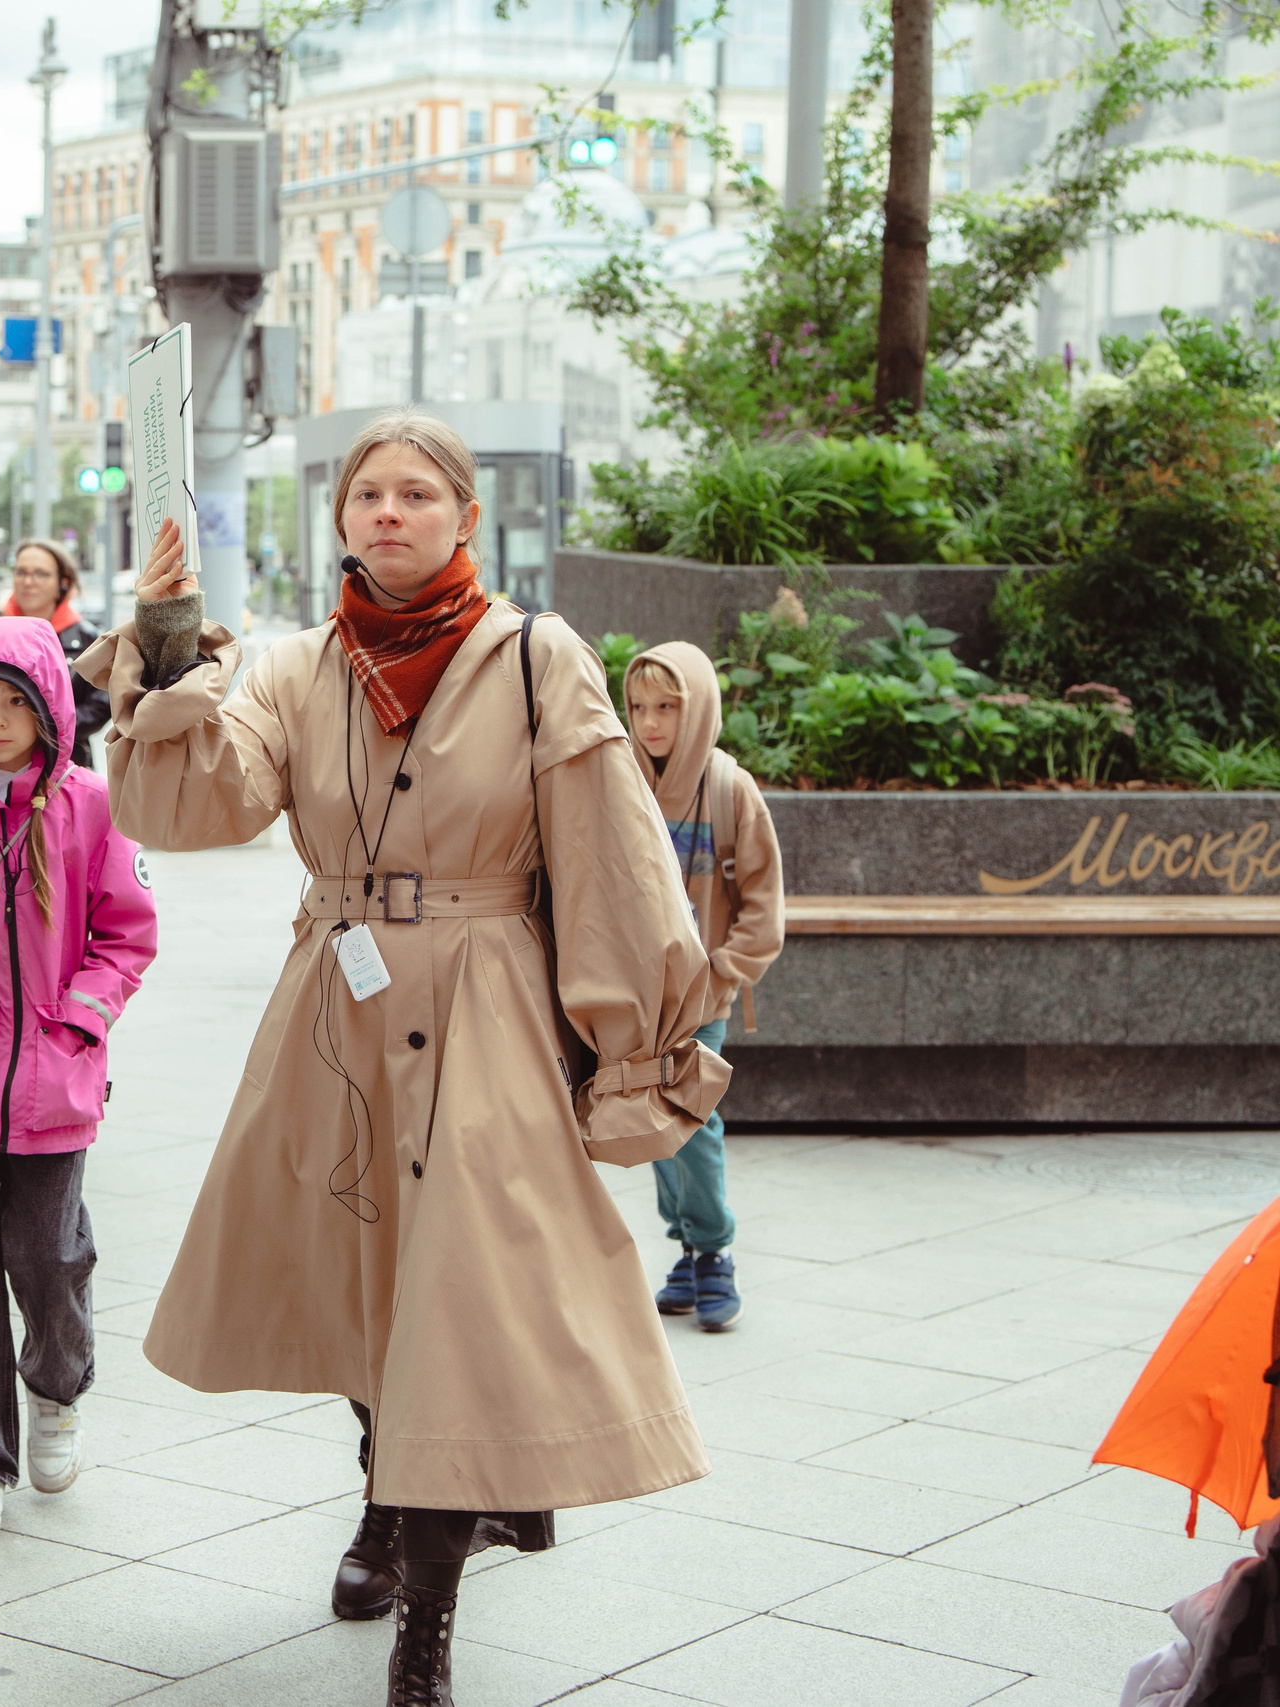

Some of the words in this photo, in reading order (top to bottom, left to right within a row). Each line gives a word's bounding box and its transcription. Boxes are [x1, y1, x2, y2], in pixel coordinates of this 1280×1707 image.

[143, 405, 154, 474] МОСКВА
[149, 393, 160, 470] ГЛАЗАМИ
[155, 376, 168, 466] ИНЖЕНЕРА
